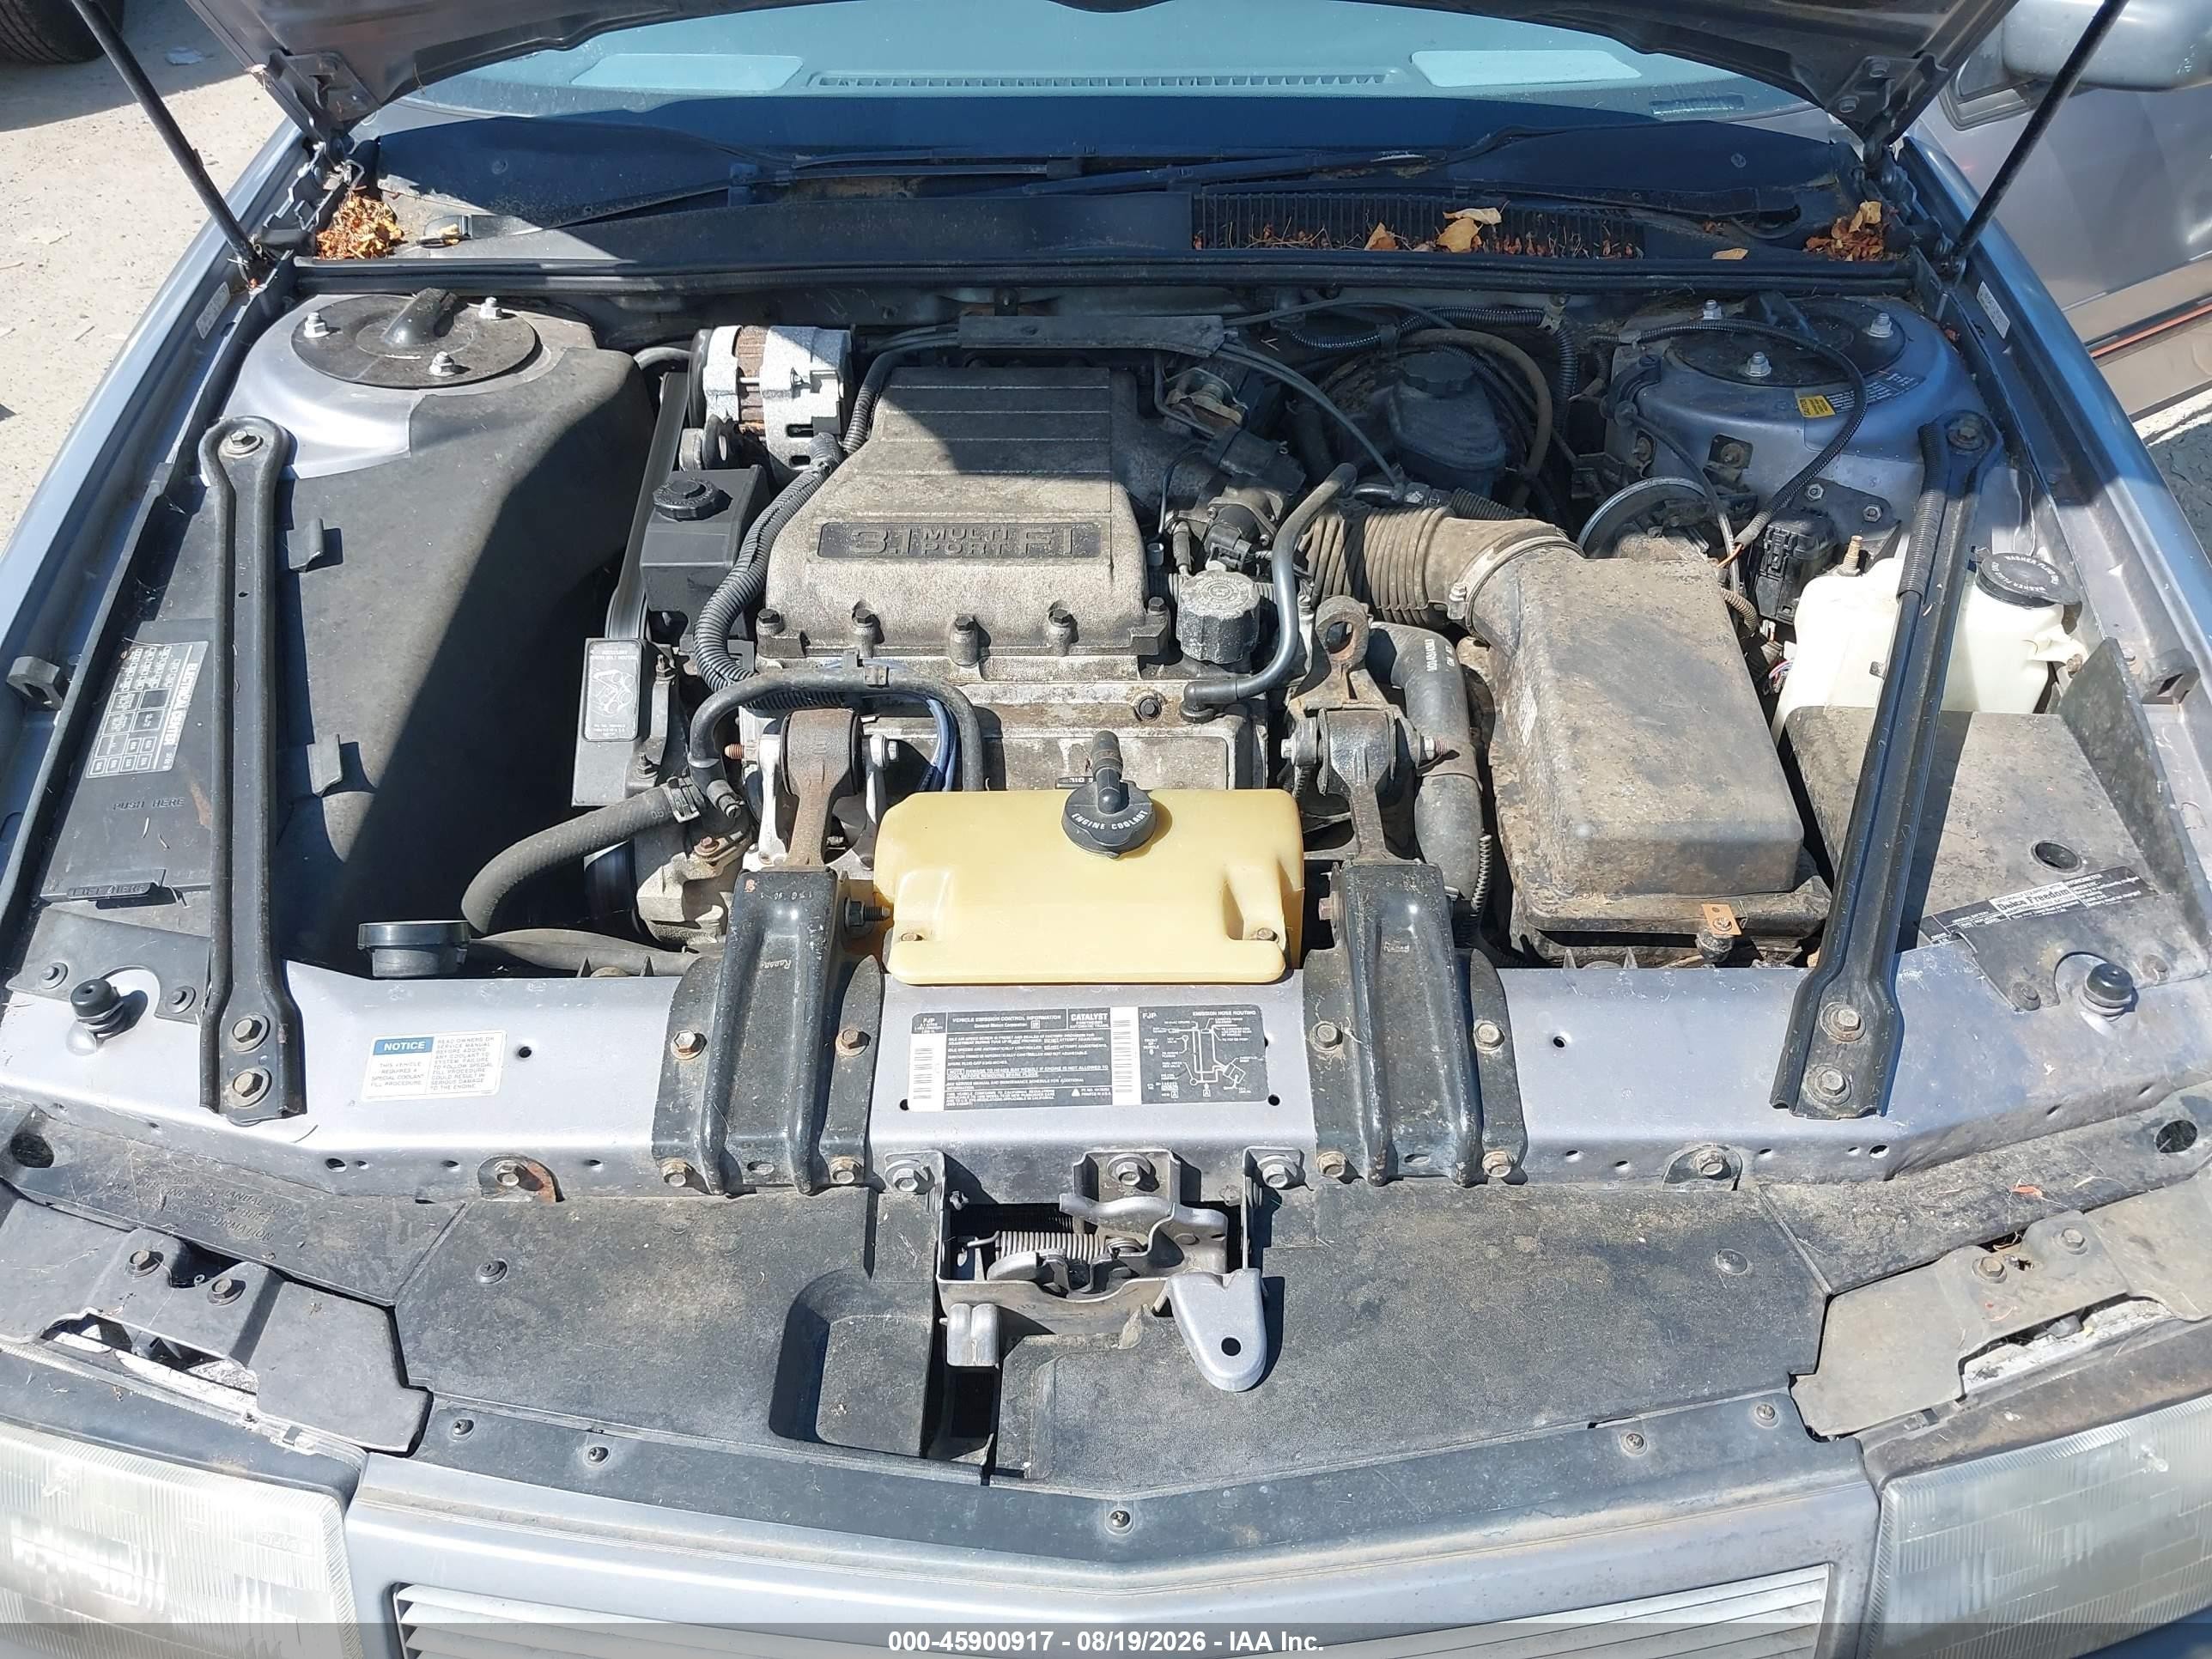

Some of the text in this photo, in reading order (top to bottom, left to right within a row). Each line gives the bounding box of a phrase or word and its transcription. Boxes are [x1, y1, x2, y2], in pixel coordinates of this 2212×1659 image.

[923, 526, 1010, 541] MULTI
[1018, 526, 1074, 556] FI
[923, 542, 1008, 556] PORT
[173, 662, 198, 711] ELECTRICAL
[162, 710, 185, 746] CENTER
[113, 797, 186, 811] PUSH HERE
[1071, 810, 1149, 830] ENGINE COOLANT
[2027, 889, 2070, 904] Freedom
[1071, 1012, 1108, 1021] CATALYST
[384, 1041, 426, 1051] NOTICE
